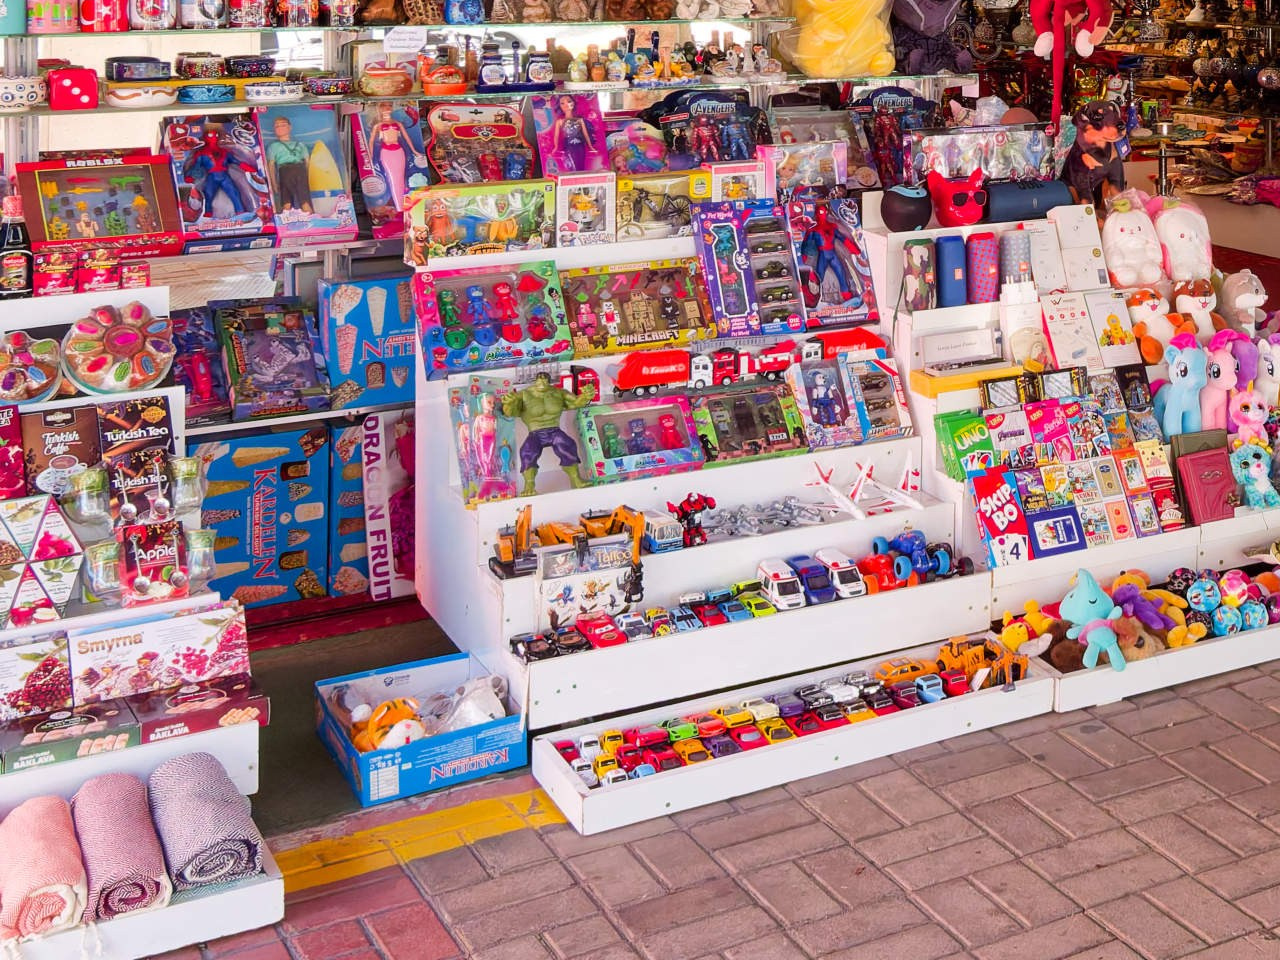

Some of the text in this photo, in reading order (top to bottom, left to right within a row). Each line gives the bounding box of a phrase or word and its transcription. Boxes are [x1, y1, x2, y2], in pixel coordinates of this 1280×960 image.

[690, 102, 737, 115] AVENGERS
[616, 330, 680, 345] MINECRAFT
[42, 430, 81, 445] Turkish
[104, 426, 169, 442] Turkish Tea
[954, 423, 989, 451] UNO
[252, 467, 279, 580] KARDELEN
[991, 503, 1019, 532] BO
[596, 550, 633, 562] Tattoo
[1009, 542, 1021, 560] 4
[369, 528, 393, 601] FRUIT
[77, 632, 143, 655] Smyrna
[149, 726, 190, 741] BAKLAVA
[13, 753, 56, 770] BAKLAVA
[429, 747, 510, 785] KARDELEN
